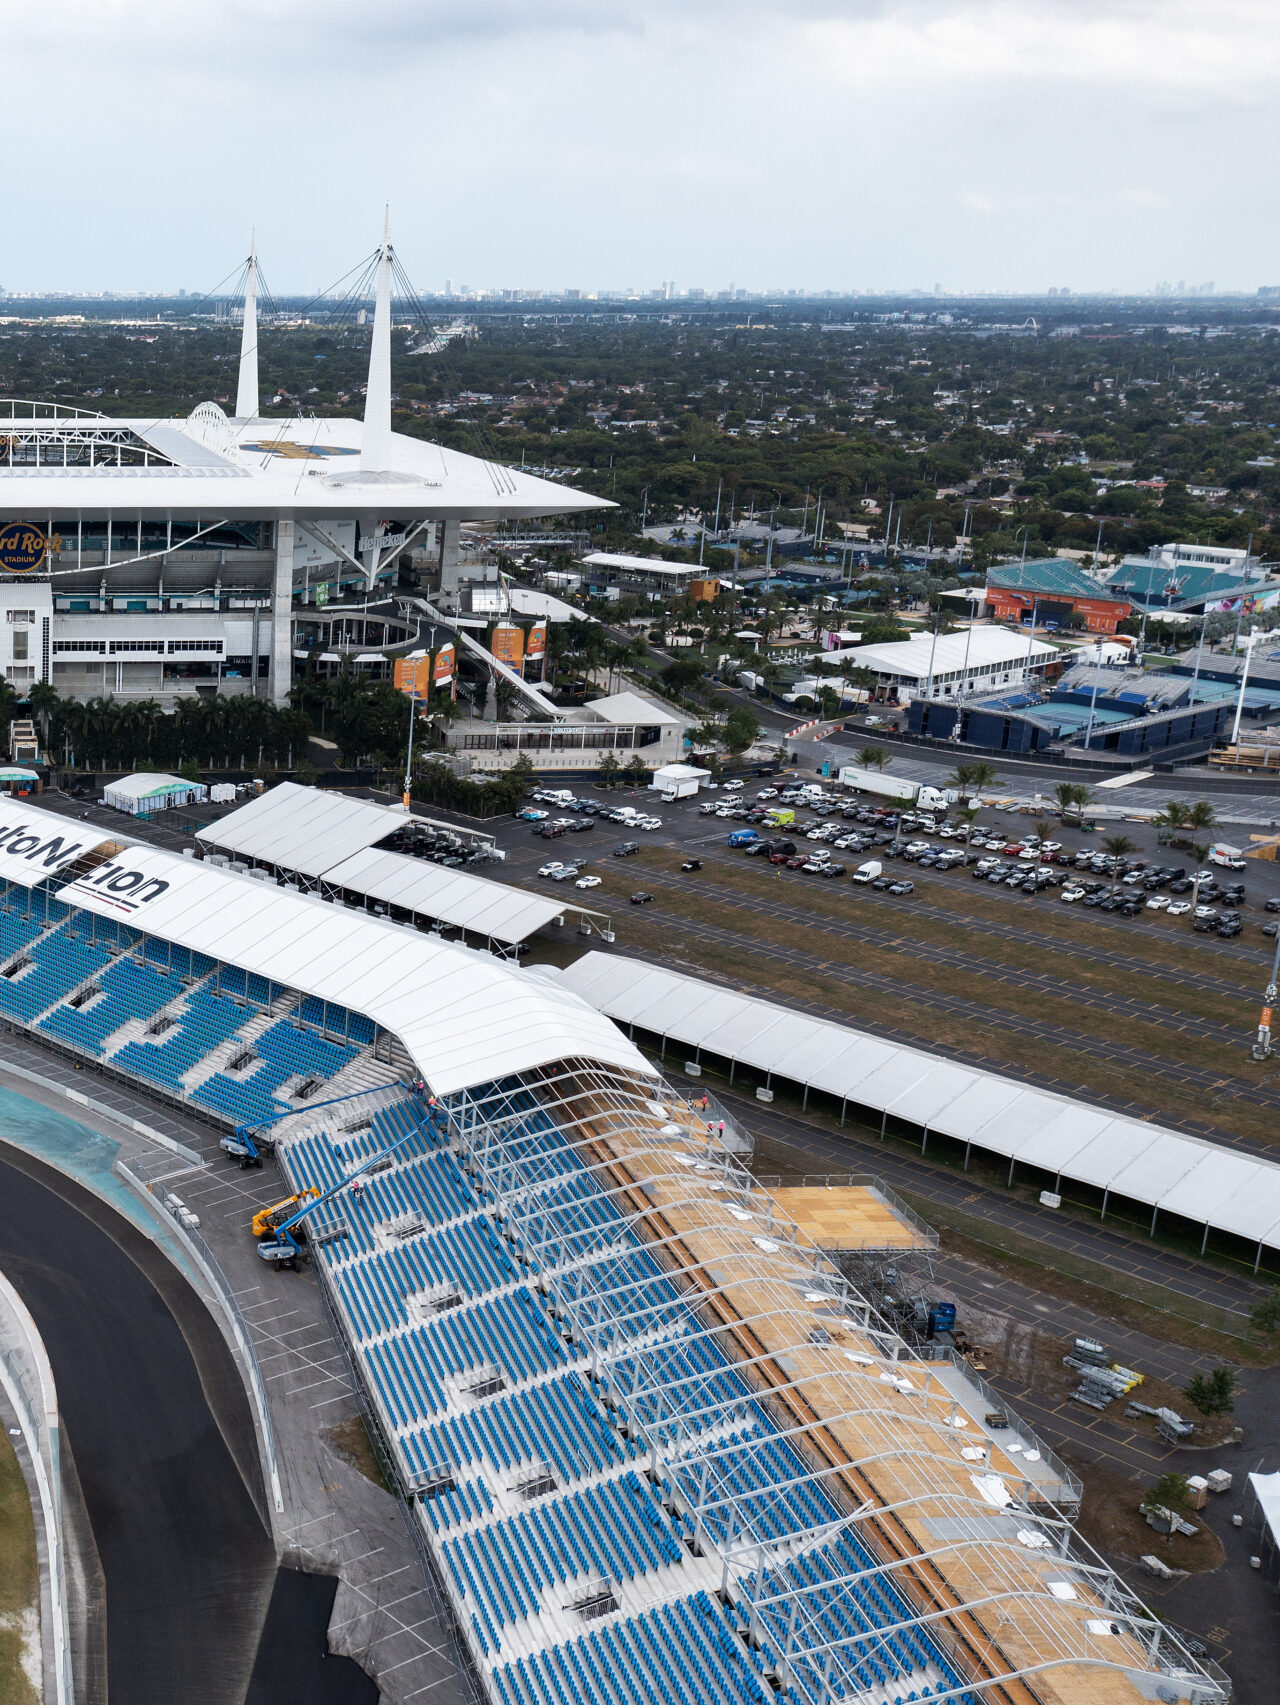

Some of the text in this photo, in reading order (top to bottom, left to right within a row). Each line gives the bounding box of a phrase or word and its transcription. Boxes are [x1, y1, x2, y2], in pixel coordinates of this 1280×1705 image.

[21, 532, 63, 554] Rock
[358, 532, 406, 552] Heineken
[517, 702, 531, 716] LEVEL
